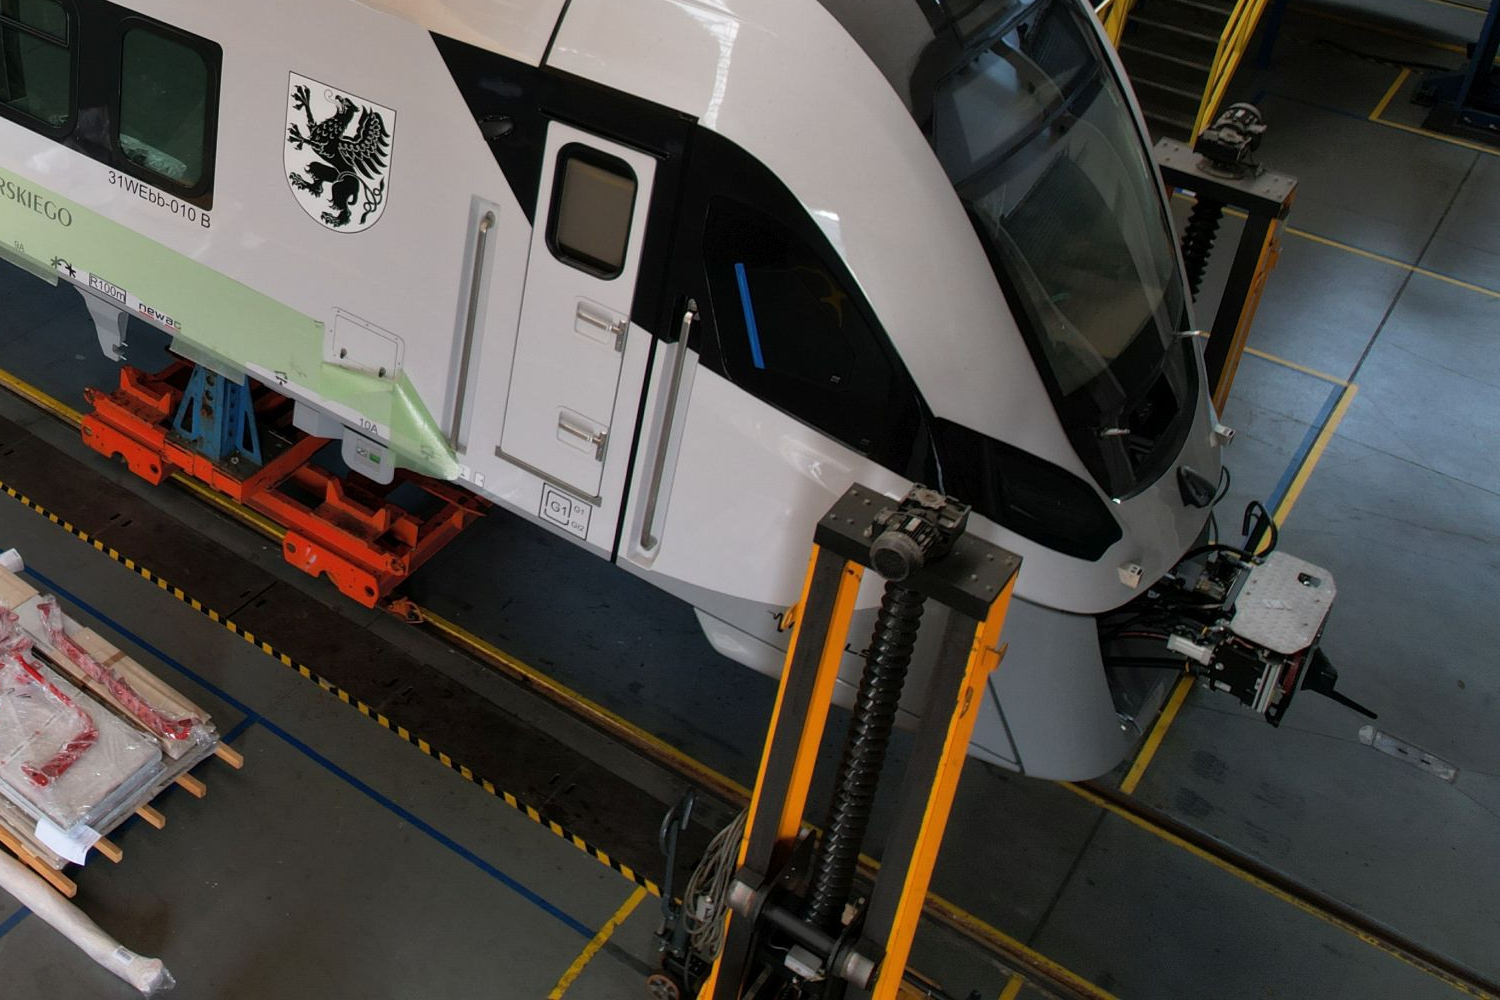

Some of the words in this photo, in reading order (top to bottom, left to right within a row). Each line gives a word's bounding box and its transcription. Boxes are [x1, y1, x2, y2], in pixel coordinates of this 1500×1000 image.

[108, 170, 196, 222] 31WEbb-010
[201, 212, 211, 228] B
[90, 276, 126, 302] R100m
[358, 417, 379, 435] 10A
[550, 500, 568, 517] G1
